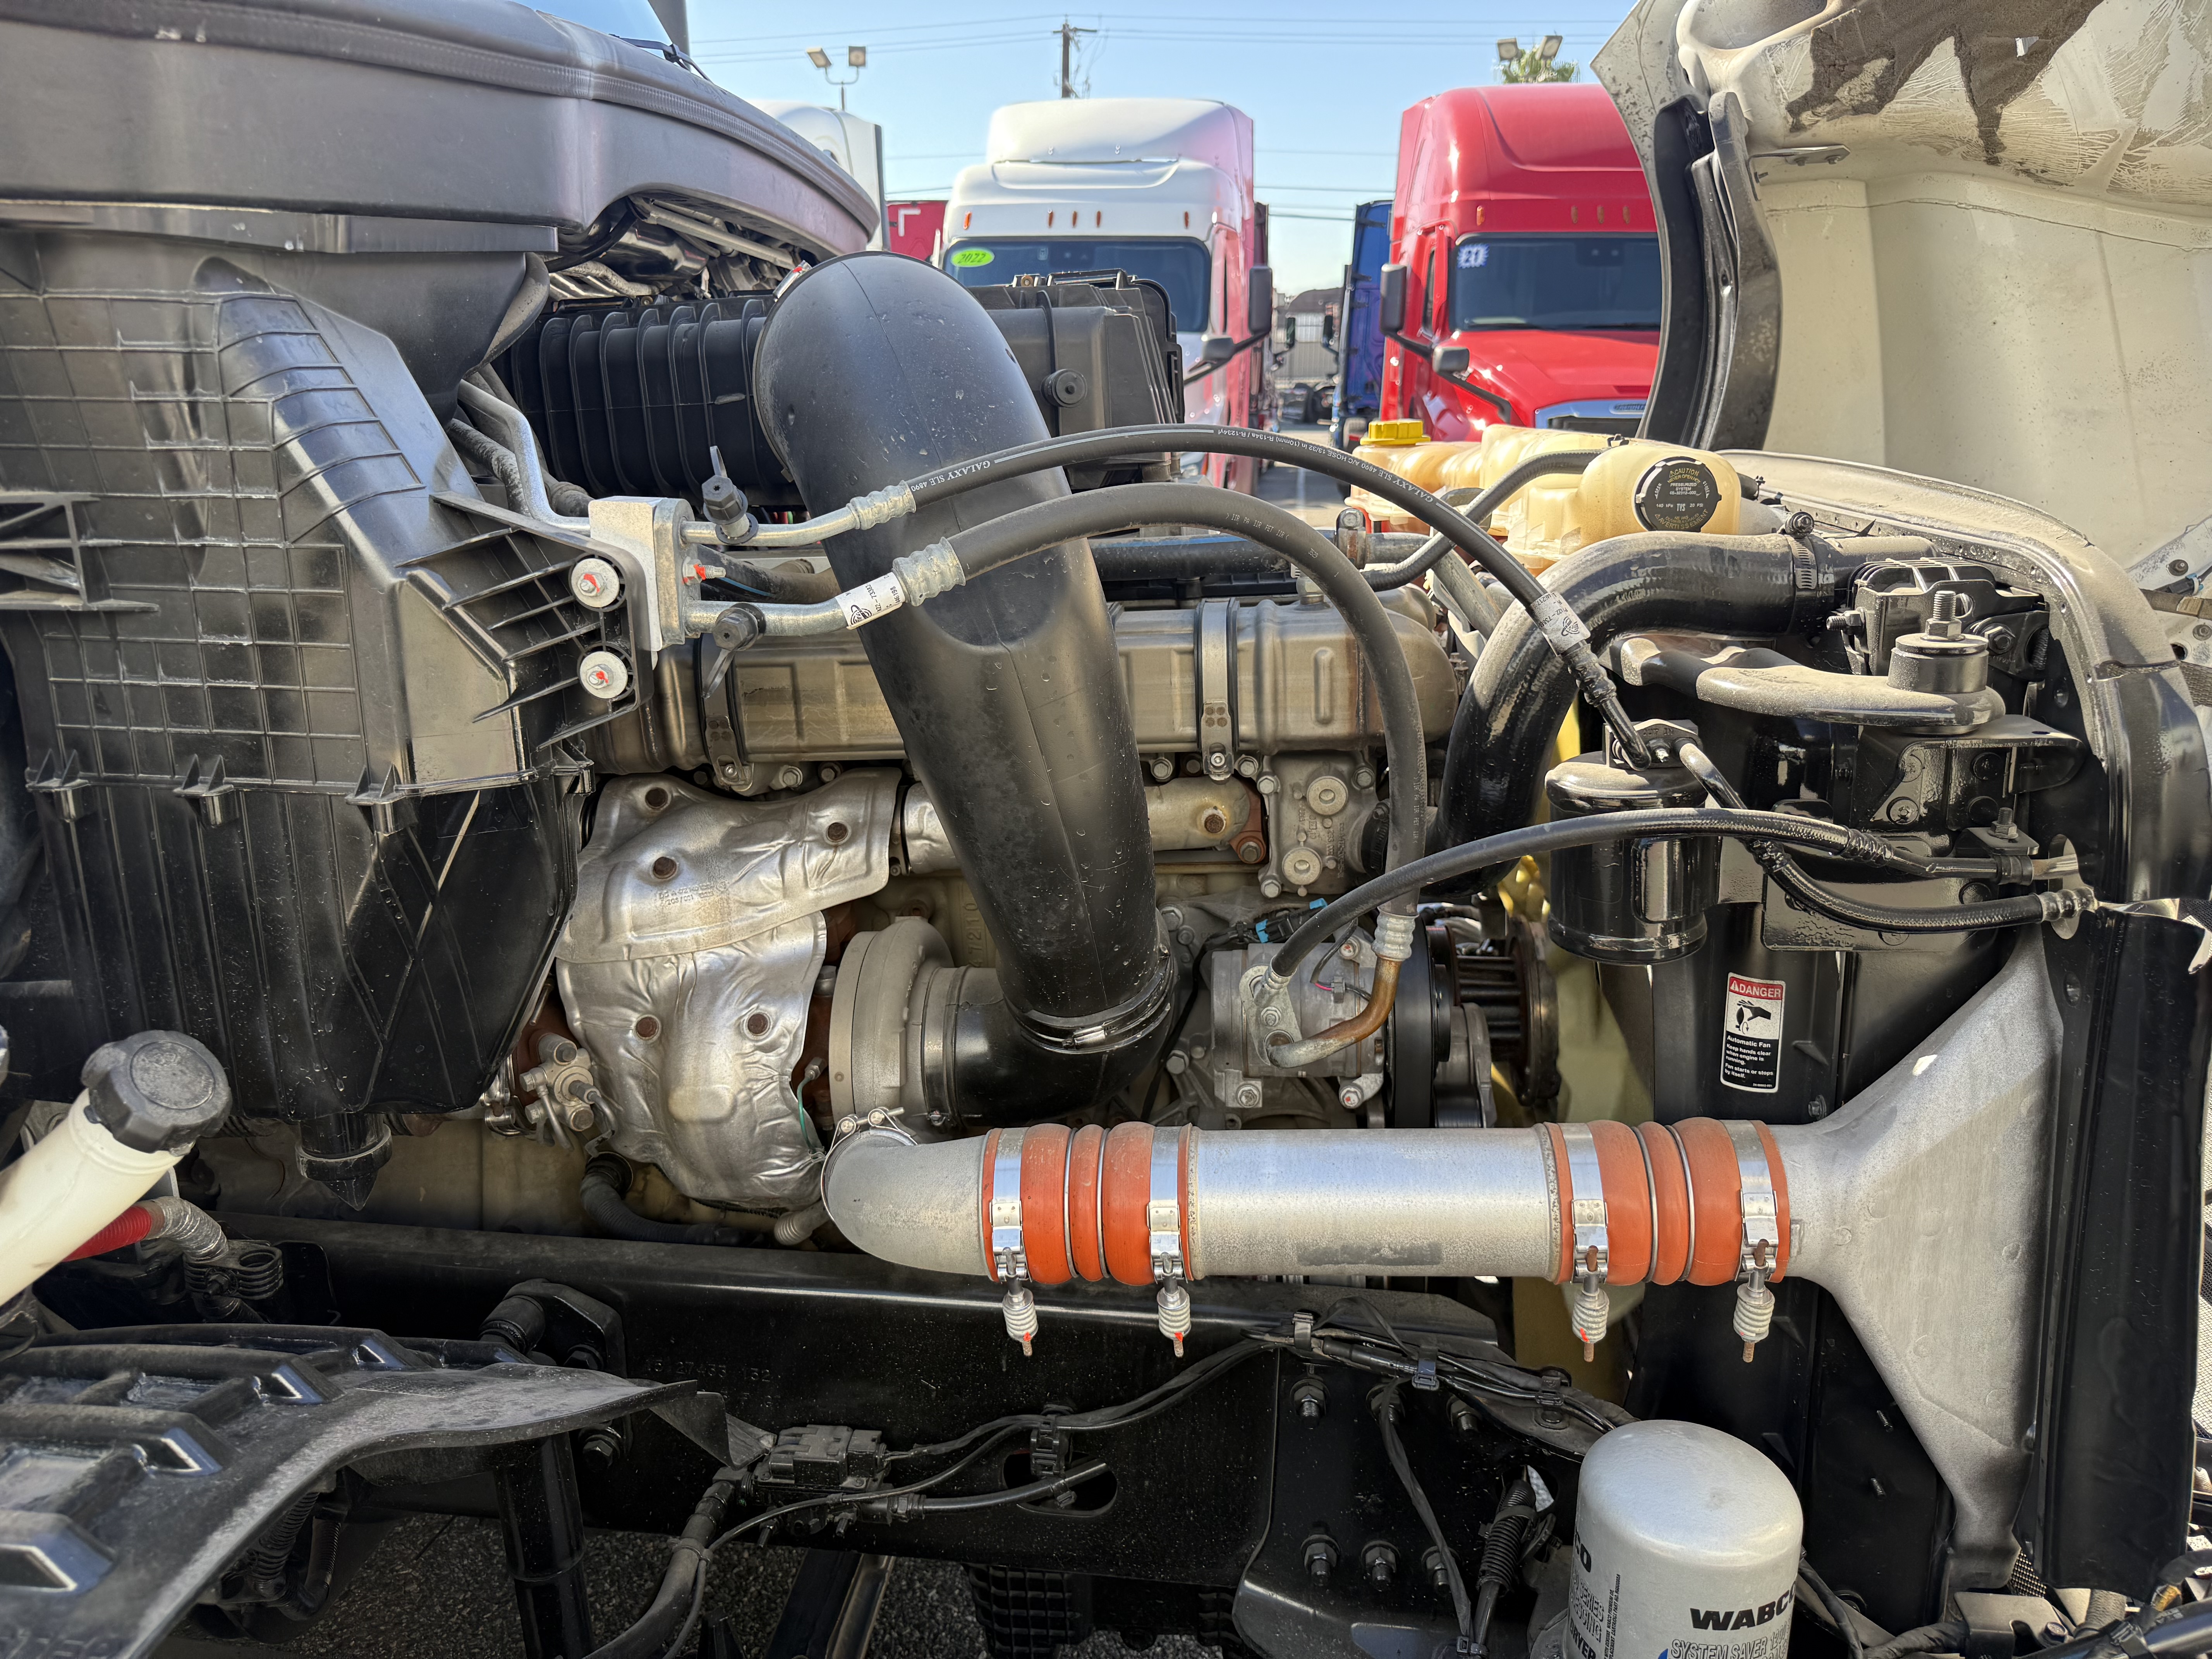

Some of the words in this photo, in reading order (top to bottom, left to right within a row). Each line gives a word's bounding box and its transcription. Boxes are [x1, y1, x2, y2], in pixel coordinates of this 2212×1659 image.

[958, 252, 986, 264] 2022
[1252, 433, 1274, 442] R-134a
[1276, 438, 1300, 447] (10mm)
[1309, 444, 1326, 454] 13/32
[1327, 450, 1347, 462] HOSE
[1348, 458, 1360, 466] A/C
[948, 460, 991, 481] GALAXY
[1361, 463, 1377, 473] 4890
[1674, 468, 1699, 477] CAUTION
[929, 475, 945, 486] SLE
[1378, 469, 1393, 481] SLE
[1667, 475, 1681, 483] NEVER
[911, 481, 927, 492] 4890
[1393, 479, 1433, 503] GALAXY
[1658, 509, 1708, 529] AVERTISSEMENT
[1685, 513, 1699, 523] CHAUD
[1740, 984, 1781, 998] DANGER
[1727, 1035, 1757, 1047] Automatic
[1727, 1043, 1739, 1052] Keep
[1726, 1056, 1746, 1065] running.
[1580, 1578, 1604, 1622] SERIES
[1690, 1580, 1797, 1631] WABCO
[1671, 1639, 1729, 1659] SYSTEM
[1730, 1637, 1768, 1659] SAVER
